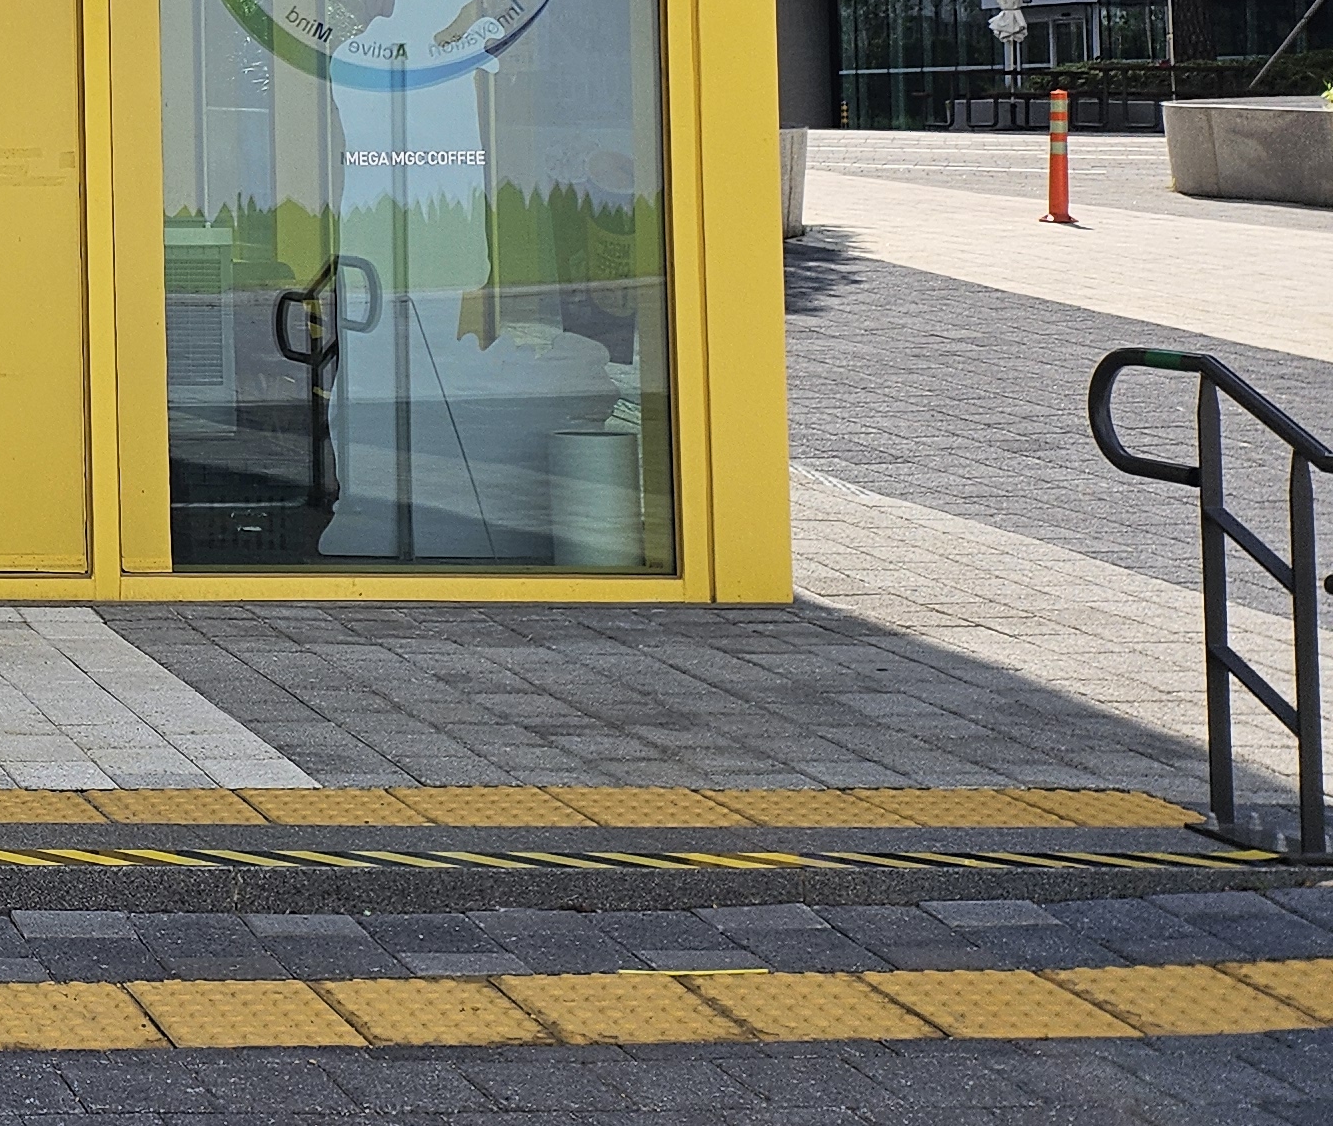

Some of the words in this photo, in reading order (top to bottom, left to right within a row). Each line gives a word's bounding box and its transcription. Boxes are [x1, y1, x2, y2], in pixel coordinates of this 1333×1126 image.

[346, 150, 390, 166] MEGA
[392, 150, 426, 166] MGC
[427, 150, 486, 166] COFFEE
